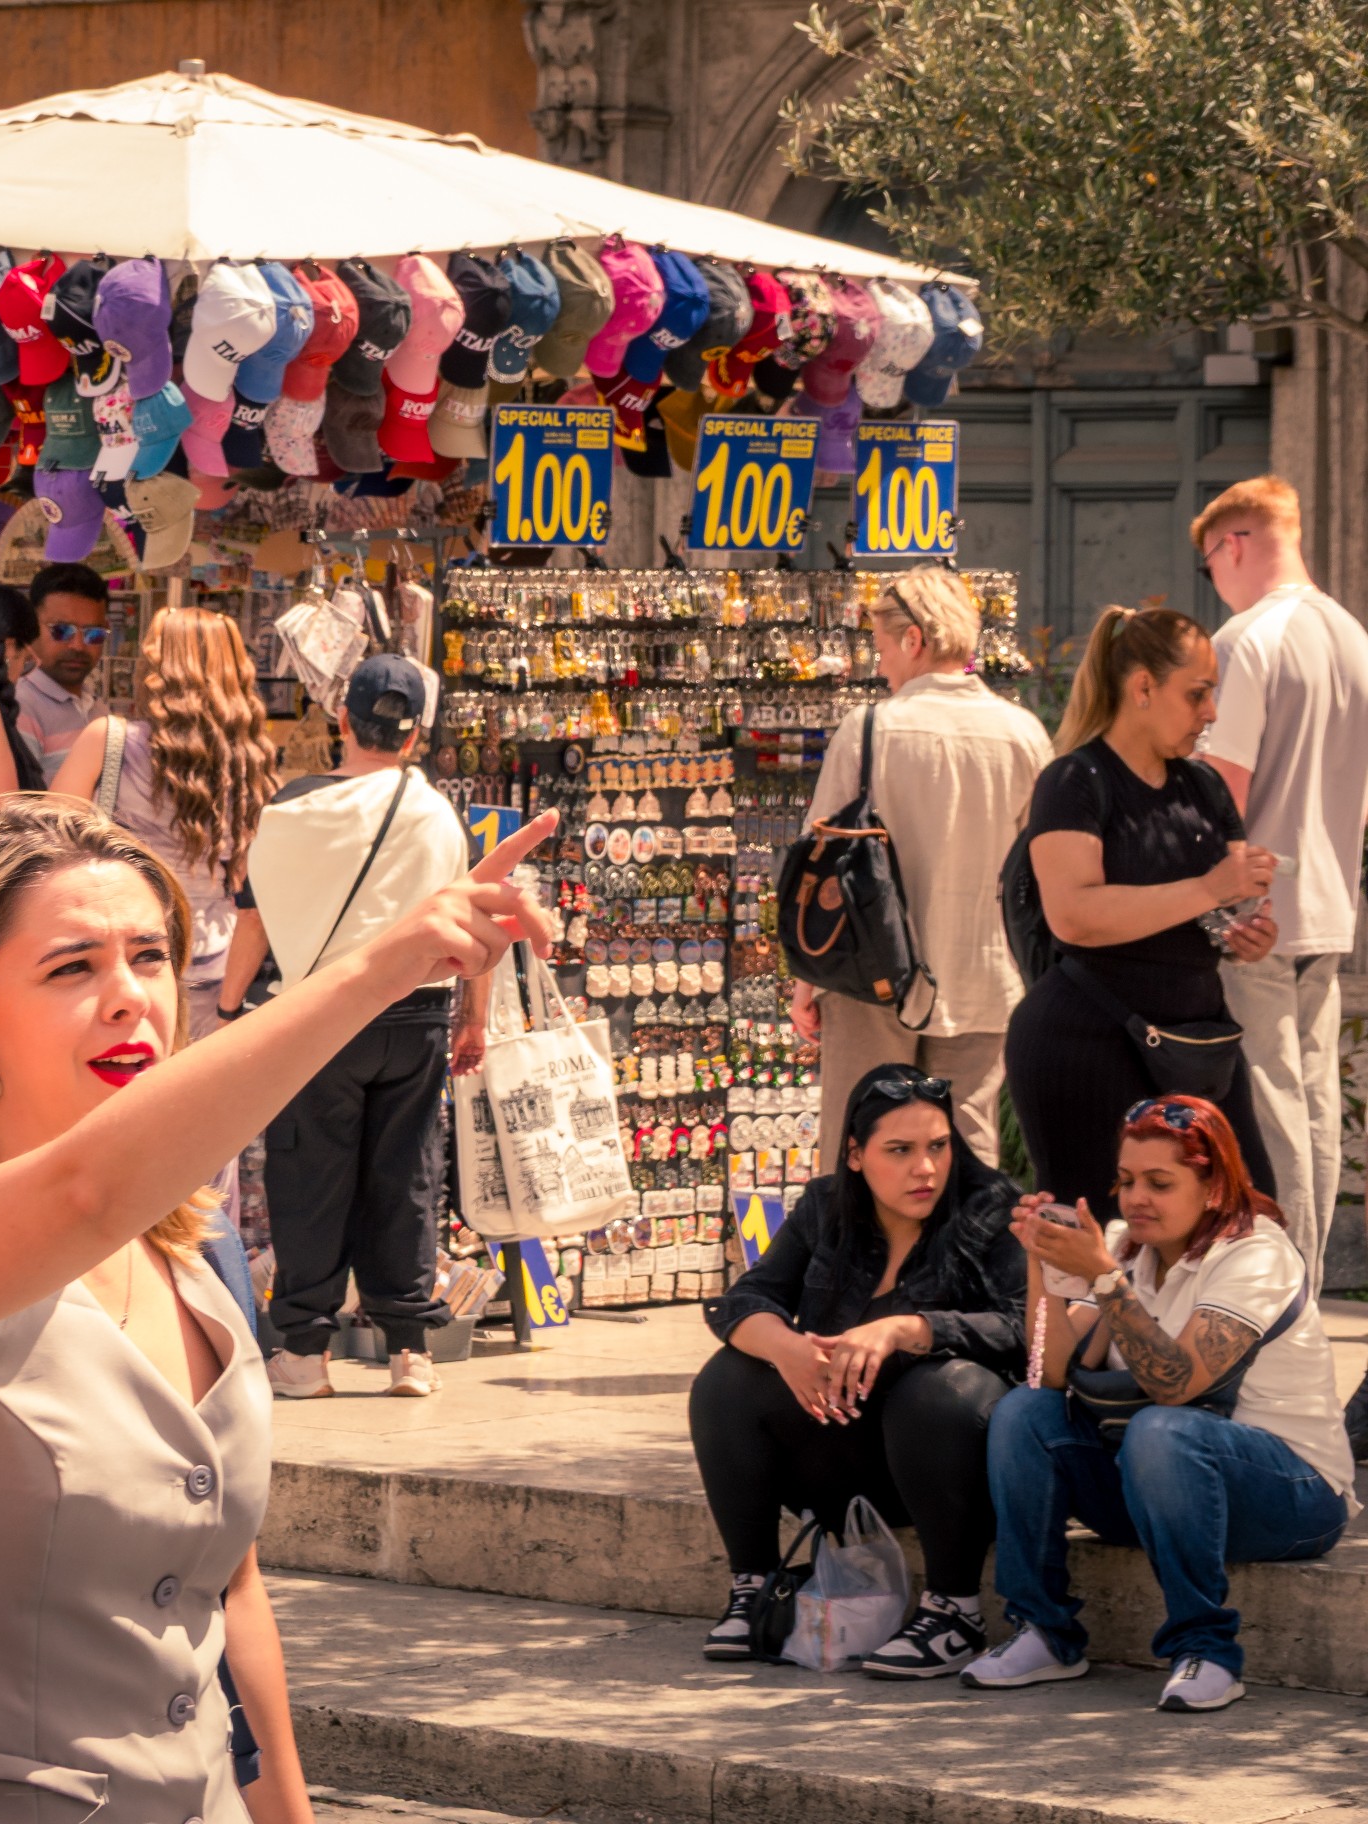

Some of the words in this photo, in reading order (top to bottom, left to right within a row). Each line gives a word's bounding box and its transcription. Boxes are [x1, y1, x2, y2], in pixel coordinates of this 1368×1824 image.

[498, 410, 563, 426] SPECIAL
[566, 412, 611, 427] PRICE
[704, 420, 768, 436] SPECIAL
[772, 422, 817, 437] PRICE
[858, 425, 912, 440] SPECIAL
[916, 426, 954, 442] PRICE
[548, 1054, 597, 1079] ROMA
